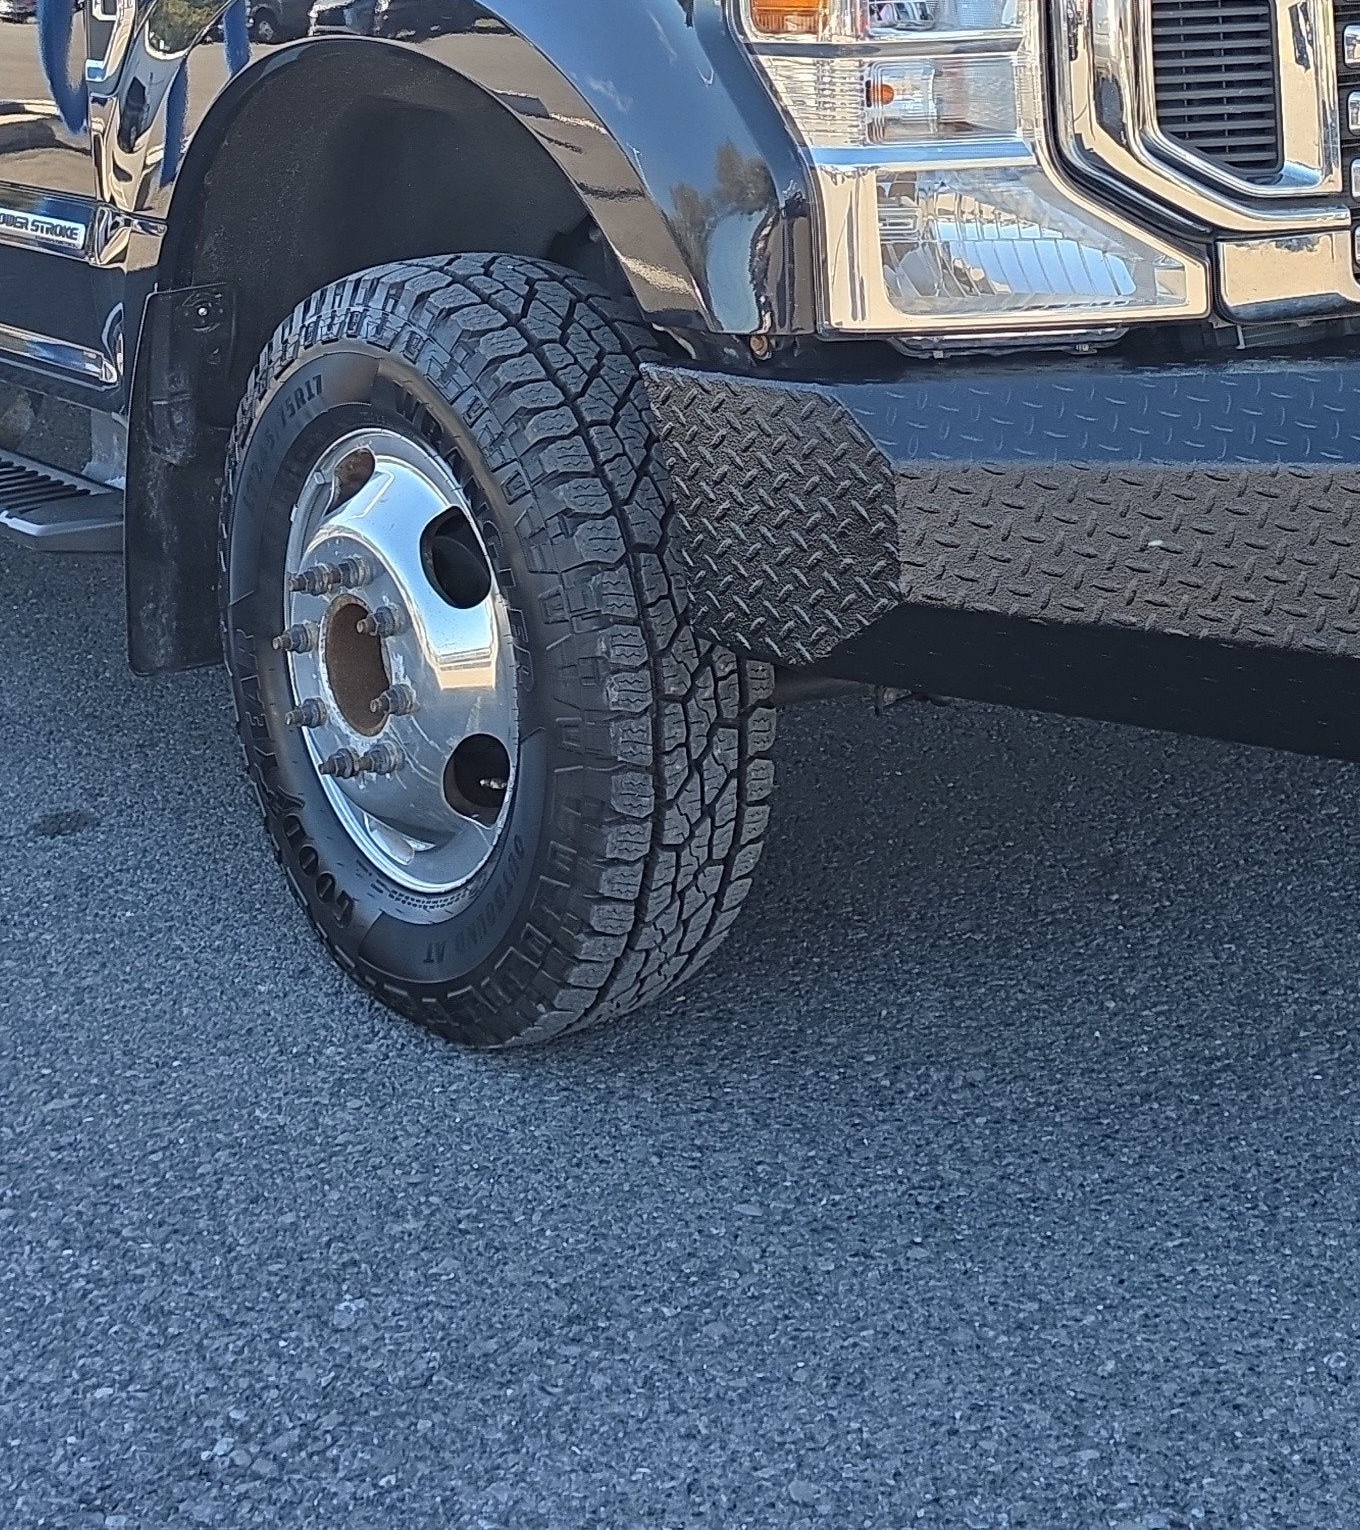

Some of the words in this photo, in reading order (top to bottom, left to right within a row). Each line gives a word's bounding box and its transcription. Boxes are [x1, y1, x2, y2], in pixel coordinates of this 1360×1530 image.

[30, 219, 80, 242] STROKE
[392, 379, 536, 693] WRANGLER
[235, 628, 356, 928] GOODYEAR
